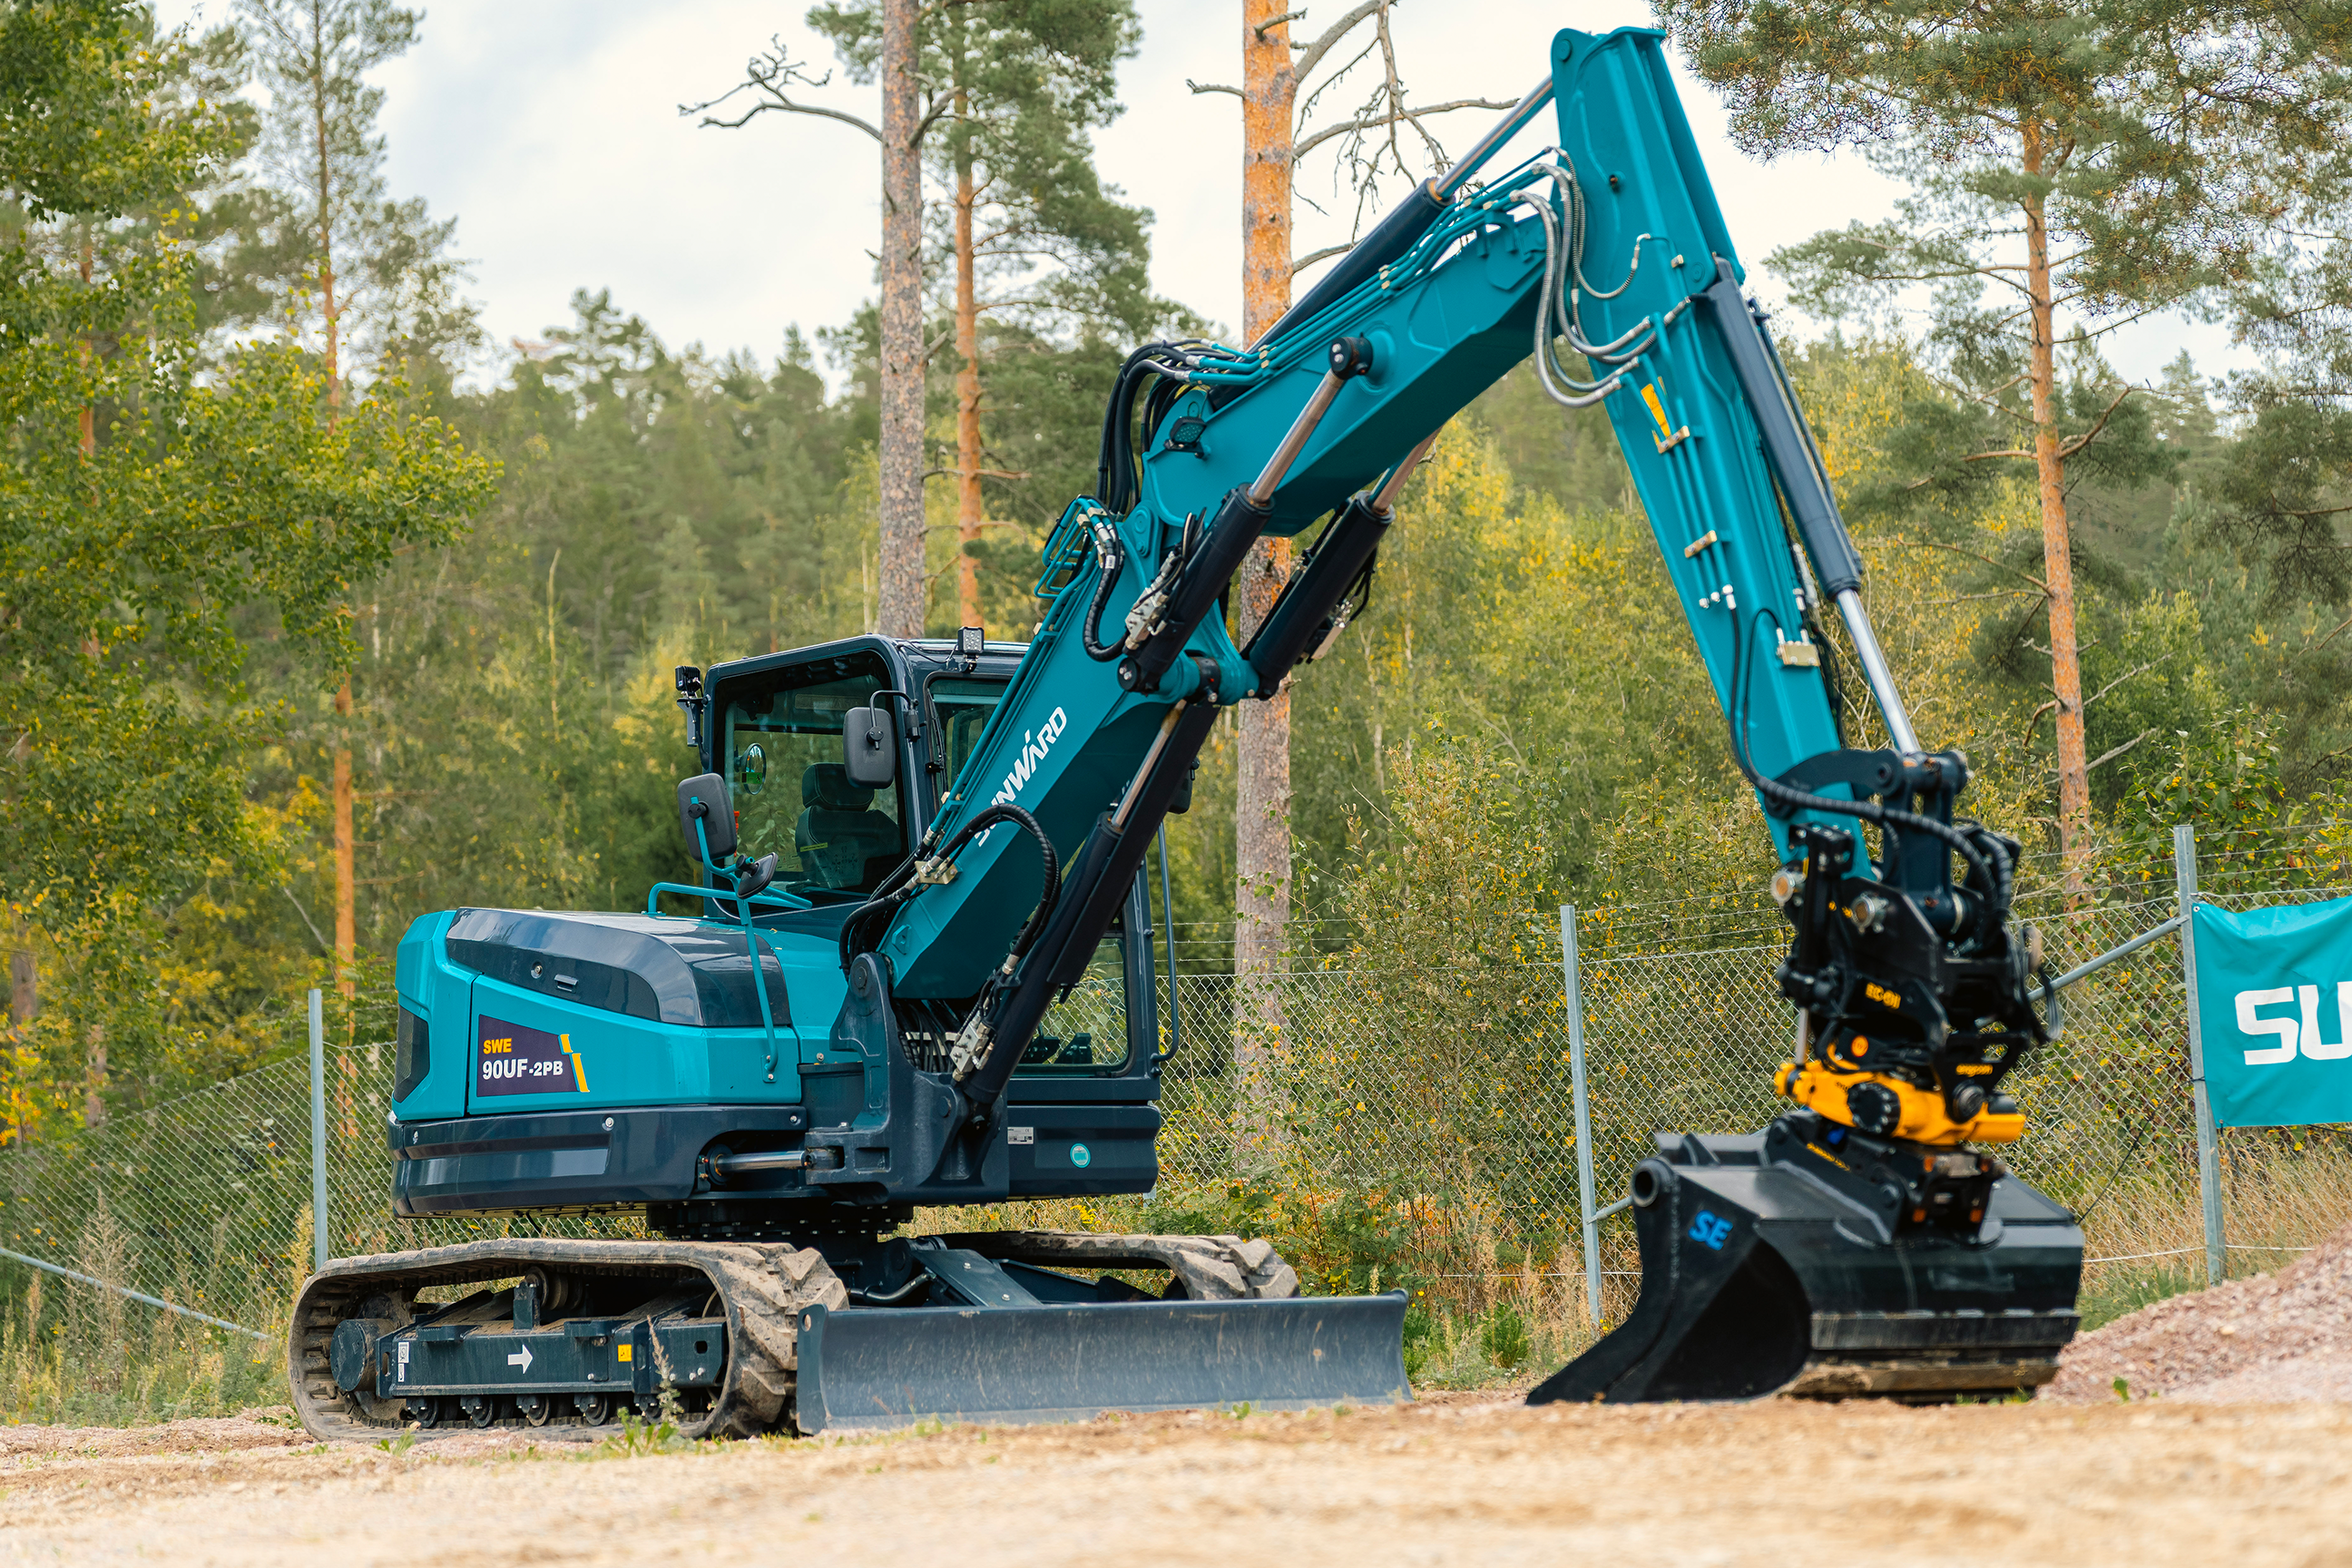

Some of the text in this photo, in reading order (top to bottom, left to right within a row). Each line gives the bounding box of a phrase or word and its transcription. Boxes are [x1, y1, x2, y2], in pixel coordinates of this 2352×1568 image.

[2234, 981, 2352, 1065] SU
[483, 1038, 513, 1054] SWE
[482, 1058, 564, 1080] 90UF-2PB
[1688, 1210, 1733, 1251] SE
